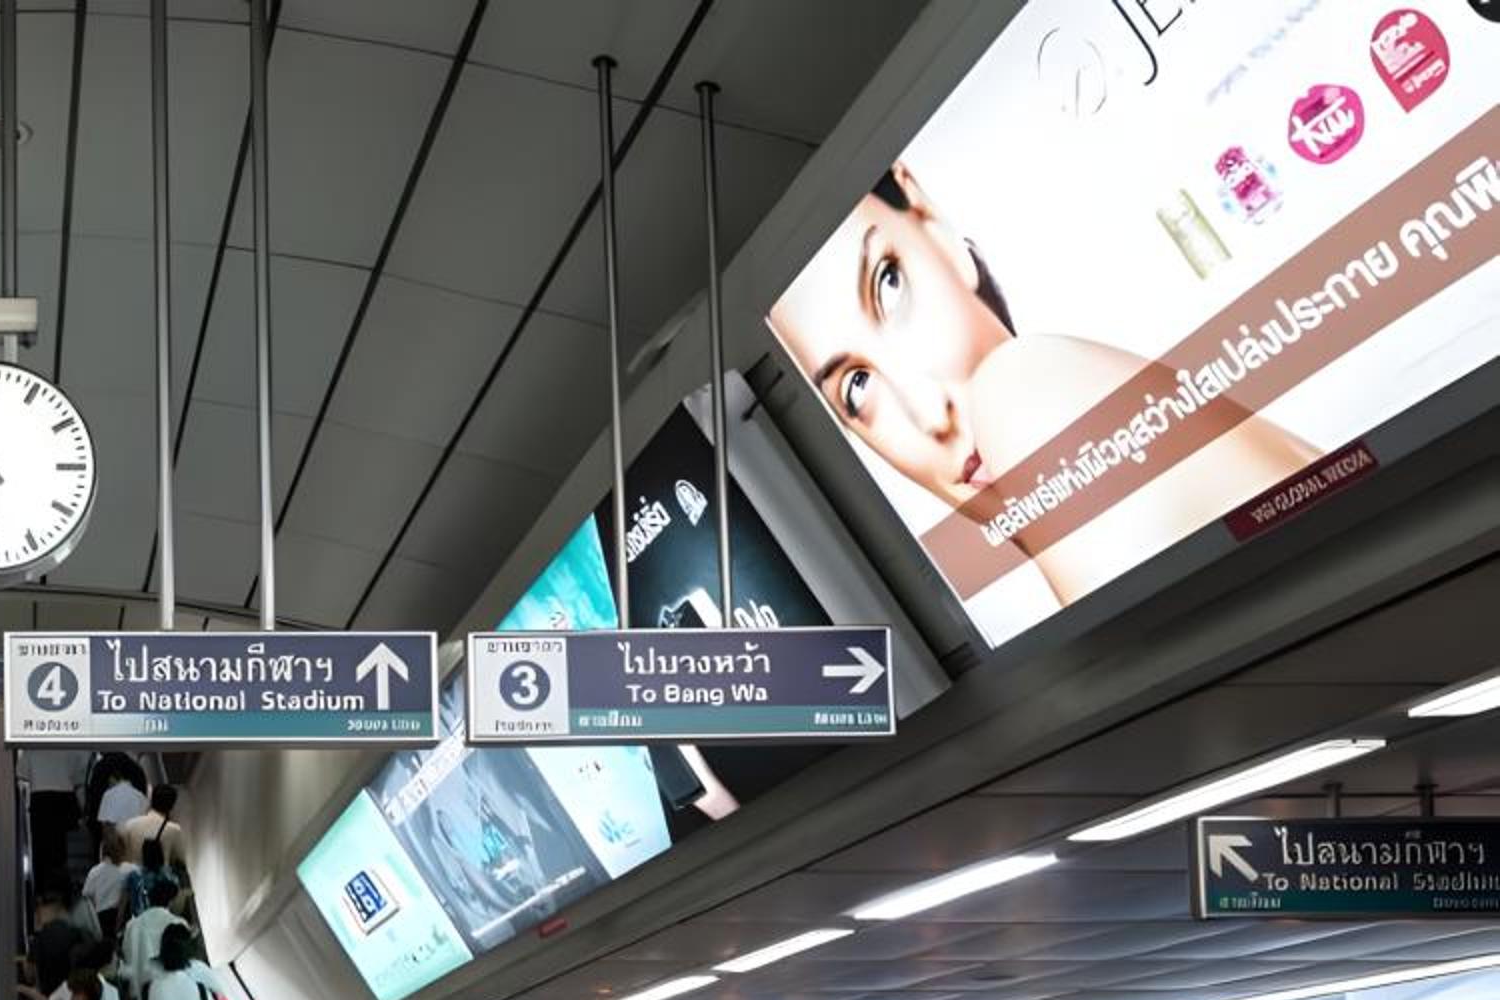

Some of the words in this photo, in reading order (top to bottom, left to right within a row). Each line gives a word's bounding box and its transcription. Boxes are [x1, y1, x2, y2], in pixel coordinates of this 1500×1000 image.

[105, 638, 333, 683] ไปสนามกีฬาฯ
[617, 641, 771, 675] ไปบางหว้า
[36, 665, 67, 707] 4
[99, 689, 127, 711] To
[139, 689, 246, 711] National
[261, 689, 365, 711] Stadium
[510, 665, 539, 705] 3
[625, 684, 657, 703] To
[663, 684, 725, 706] Bang
[730, 683, 768, 702] Wa
[1262, 872, 1289, 891] To
[1300, 872, 1398, 891] National
